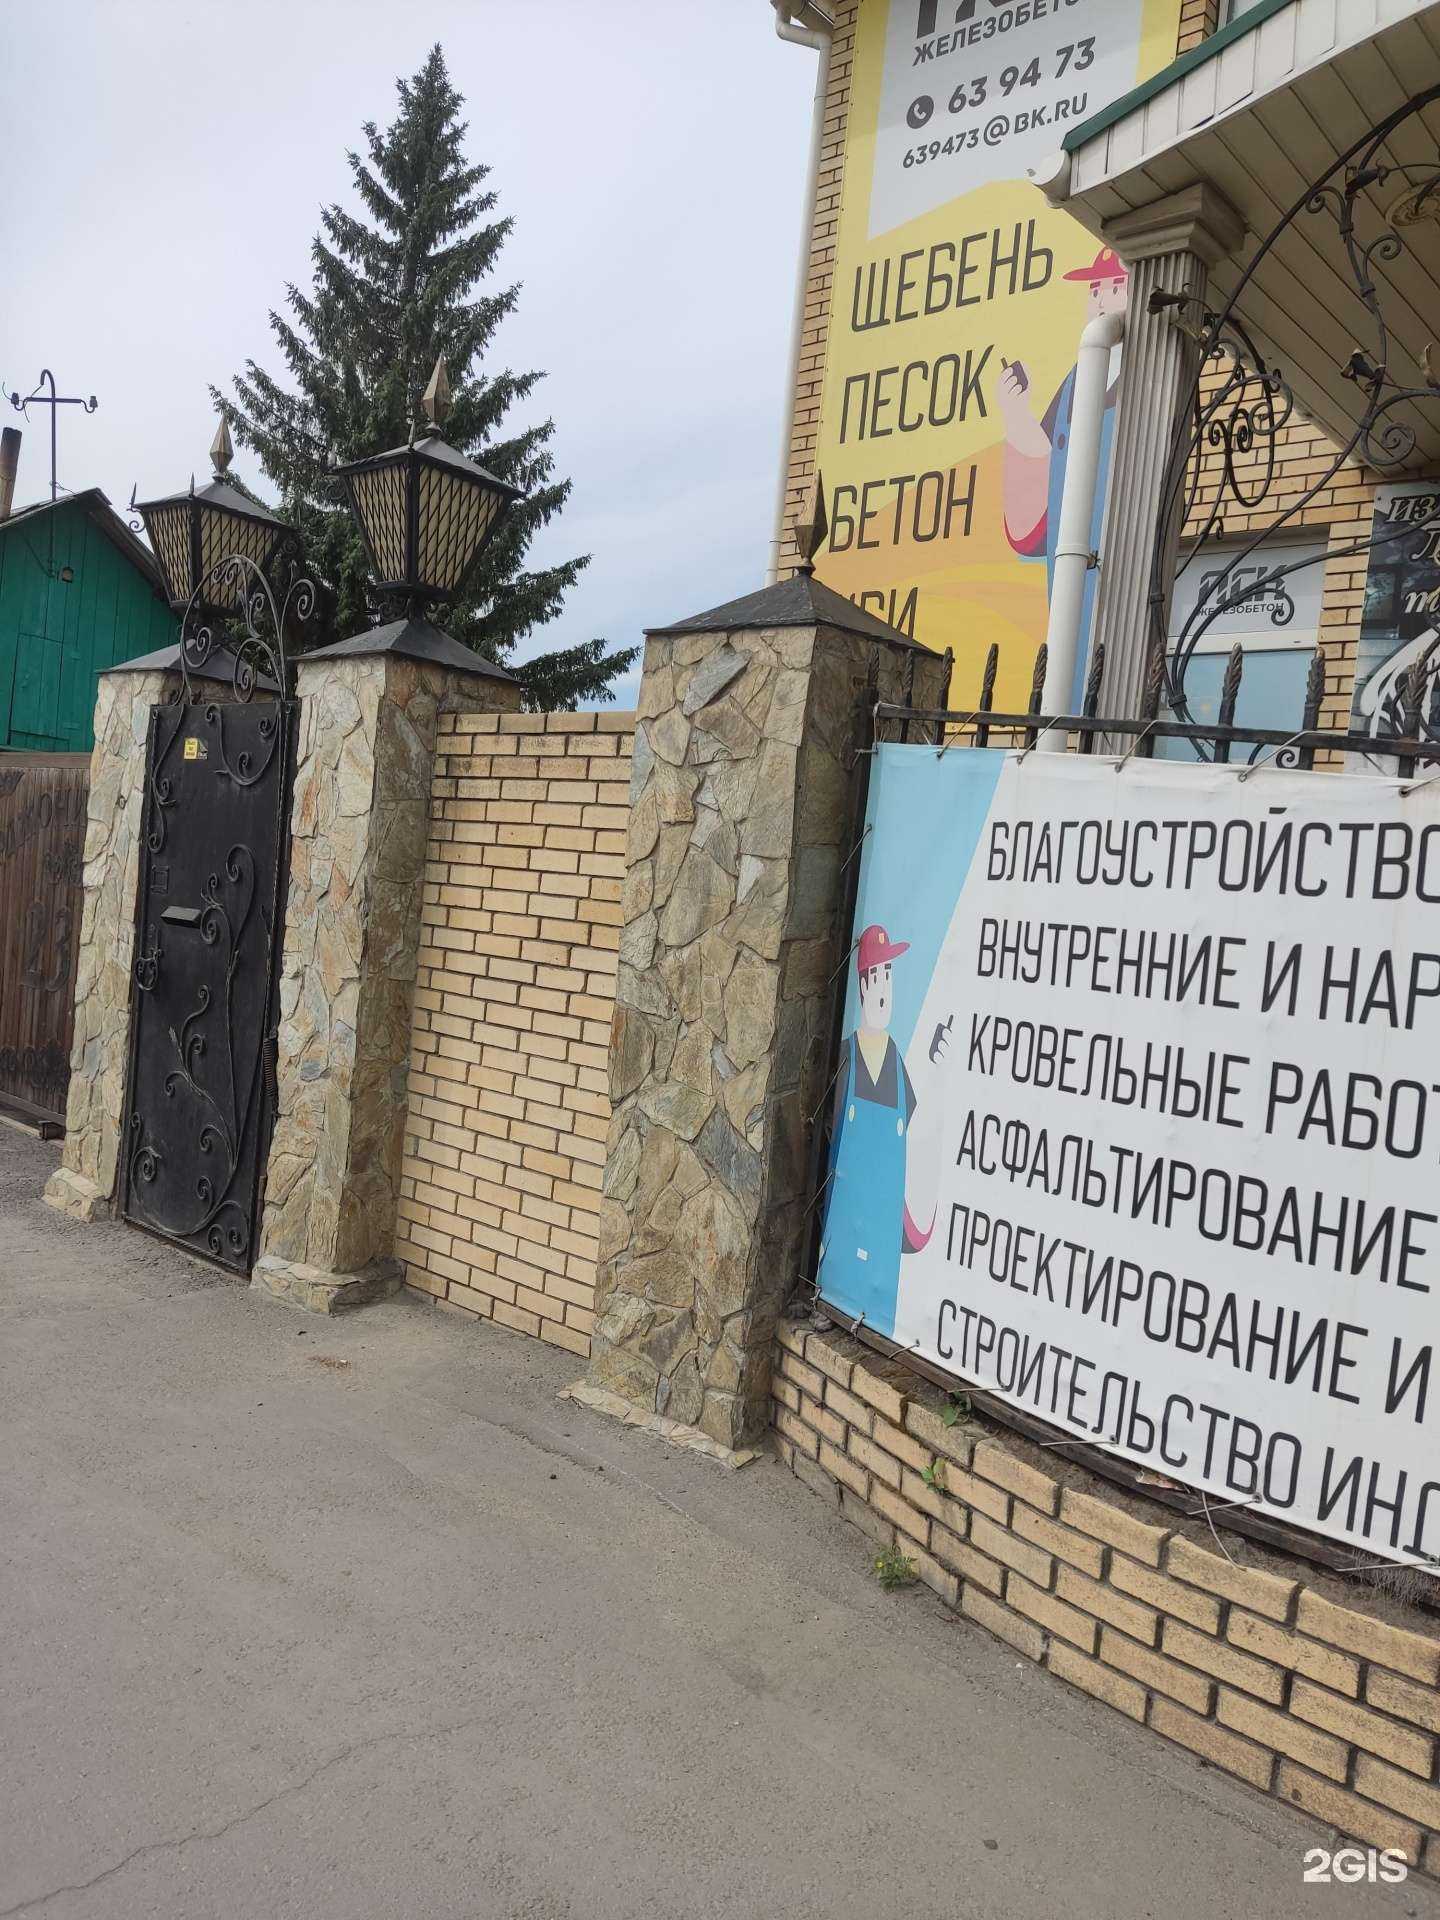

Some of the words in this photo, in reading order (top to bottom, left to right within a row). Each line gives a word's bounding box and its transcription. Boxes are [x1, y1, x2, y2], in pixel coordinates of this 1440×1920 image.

[912, 0, 1079, 66] ЖЕЛЕЗОБЕ
[948, 76, 988, 113] 63
[1000, 57, 1041, 96] 94
[1054, 37, 1095, 79] 73
[851, 219, 1053, 333] ЩЕБЕНЬ
[840, 345, 994, 443] ПЕСОК
[829, 465, 977, 553] БЕТОН
[987, 807, 1440, 903] БЛАГОУСТРОЙСТВО
[977, 918, 1246, 1009] ВНУТРЕННИЕ
[1261, 943, 1302, 1017] И
[967, 1013, 1250, 1128] КРОВЕЛЬНЫЕ
[1265, 1061, 1440, 1168] РАБО
[957, 1110, 1438, 1293] АСФАЛЬТИРОВАНИЕ
[946, 1203, 1368, 1404] ПРОЕКТИРОВАНИЕ
[1385, 1337, 1431, 1424] И
[936, 1300, 1302, 1508] СТРОИТЕЛЬСТВО
